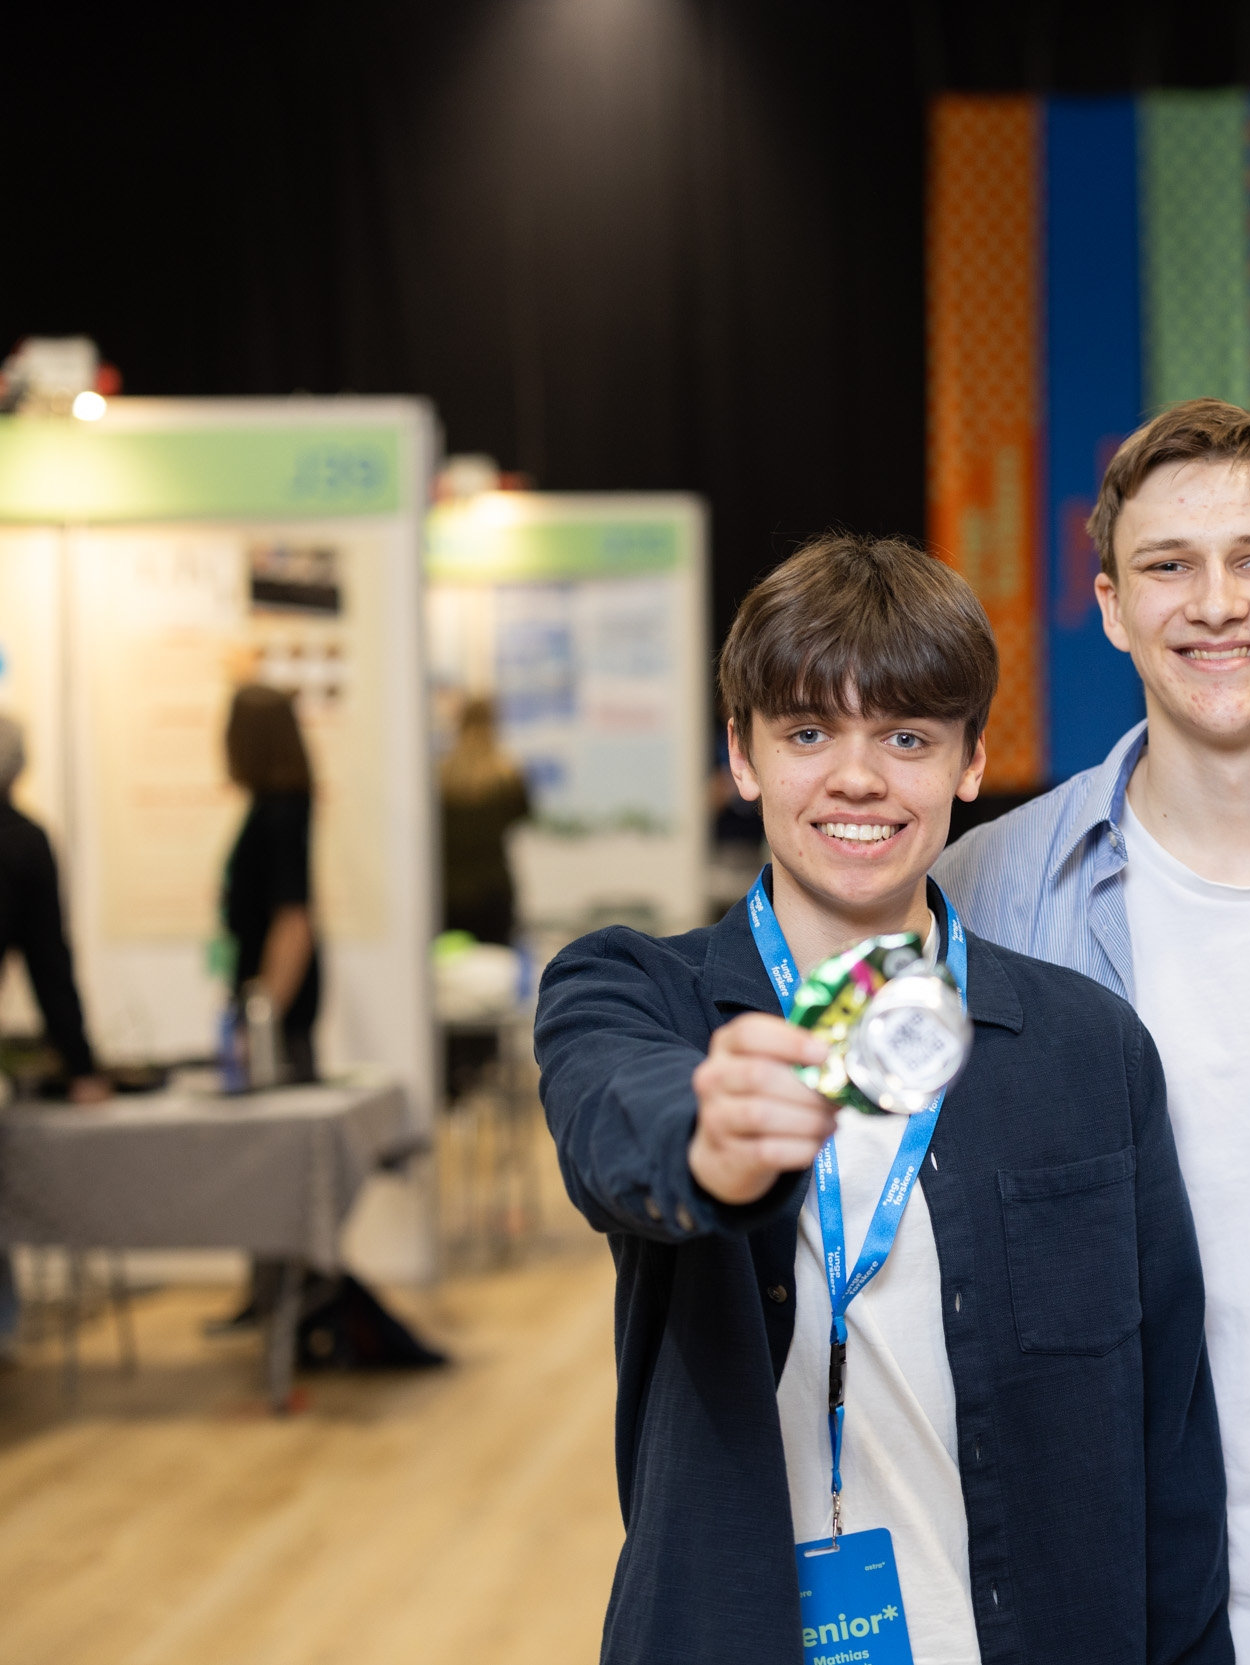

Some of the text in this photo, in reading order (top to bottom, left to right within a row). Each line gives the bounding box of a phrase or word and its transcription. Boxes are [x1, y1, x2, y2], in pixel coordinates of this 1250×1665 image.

[771, 966, 789, 997] forskere
[892, 1165, 915, 1206] forskere
[827, 1252, 837, 1295] forskere
[849, 1260, 879, 1295] forskere
[802, 1604, 899, 1647] enior
[813, 1649, 870, 1665] Mathias
